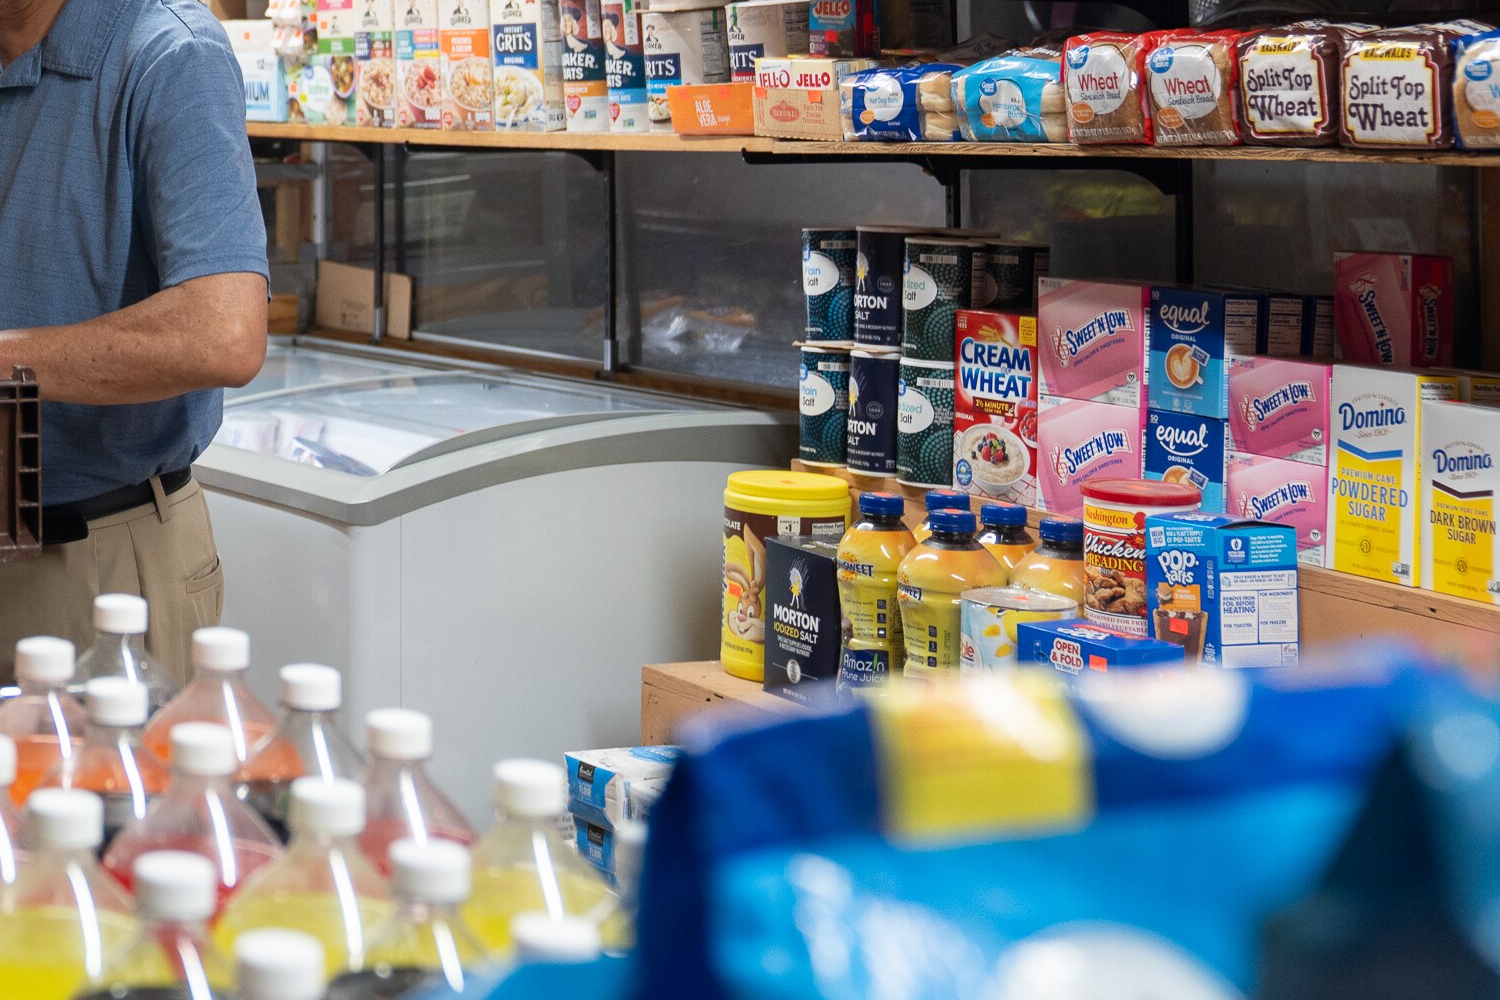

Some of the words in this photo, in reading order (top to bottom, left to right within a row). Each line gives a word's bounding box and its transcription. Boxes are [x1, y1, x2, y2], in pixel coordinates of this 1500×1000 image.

[496, 31, 533, 53] GRITS
[503, 57, 525, 65] ORIGINAL
[1077, 72, 1119, 91] Wheat
[1163, 75, 1211, 96] Wheat
[1246, 69, 1282, 92] Split
[1282, 66, 1312, 91] Top
[1349, 75, 1389, 100] Split
[1390, 75, 1425, 100] Top
[1080, 93, 1105, 101] Sandwich
[1106, 91, 1121, 100] Bread
[1167, 96, 1196, 106] Sandwich
[1196, 95, 1215, 103] Bread
[695, 99, 712, 114] ALOE
[1249, 93, 1318, 121] Wheat
[697, 111, 717, 127] VERA
[1348, 102, 1429, 131] Wheat
[806, 276, 819, 287] Salt
[1103, 311, 1127, 336] LOW
[1159, 300, 1210, 328] equal
[1101, 337, 1125, 352] SWEETENER
[1171, 333, 1197, 343] ORIGINAL
[1426, 338, 1439, 357] LOW
[960, 338, 1031, 372] CREAM
[1375, 337, 1394, 365] LOW
[961, 367, 1032, 399] WHEAT
[802, 396, 816, 407] Salt
[1287, 383, 1309, 405] LOW
[984, 401, 1010, 411] MINUTE
[955, 411, 975, 421] ORIGINAL
[1150, 413, 1160, 423] 50
[1338, 402, 1406, 431] Domino
[1102, 431, 1125, 456] LOW
[1156, 423, 1209, 450] equal
[1098, 458, 1123, 471] SWEETENER
[1168, 455, 1195, 466] ORIGINAL
[1432, 449, 1492, 474] Domino
[1341, 467, 1373, 481] PREMIUM
[1376, 473, 1396, 485] CANE
[1286, 483, 1308, 505] LOW
[1332, 477, 1408, 508] POWDERED
[1348, 500, 1386, 522] SUGAR
[1430, 509, 1455, 528] DARK
[1457, 515, 1496, 536] BROWN
[1085, 532, 1146, 560] Chicken
[1447, 528, 1477, 545] SUGAR
[1086, 554, 1144, 573] BREADING
[1165, 568, 1194, 585] tarts
[773, 603, 819, 633] MORTON
[1223, 606, 1256, 614] HEATING
[773, 621, 800, 639] IODIZED
[799, 629, 818, 645] SALT
[1055, 639, 1079, 654] OPEN
[1060, 654, 1083, 668] FOLD
[842, 670, 858, 682] Prune
[860, 672, 886, 684] Juice
